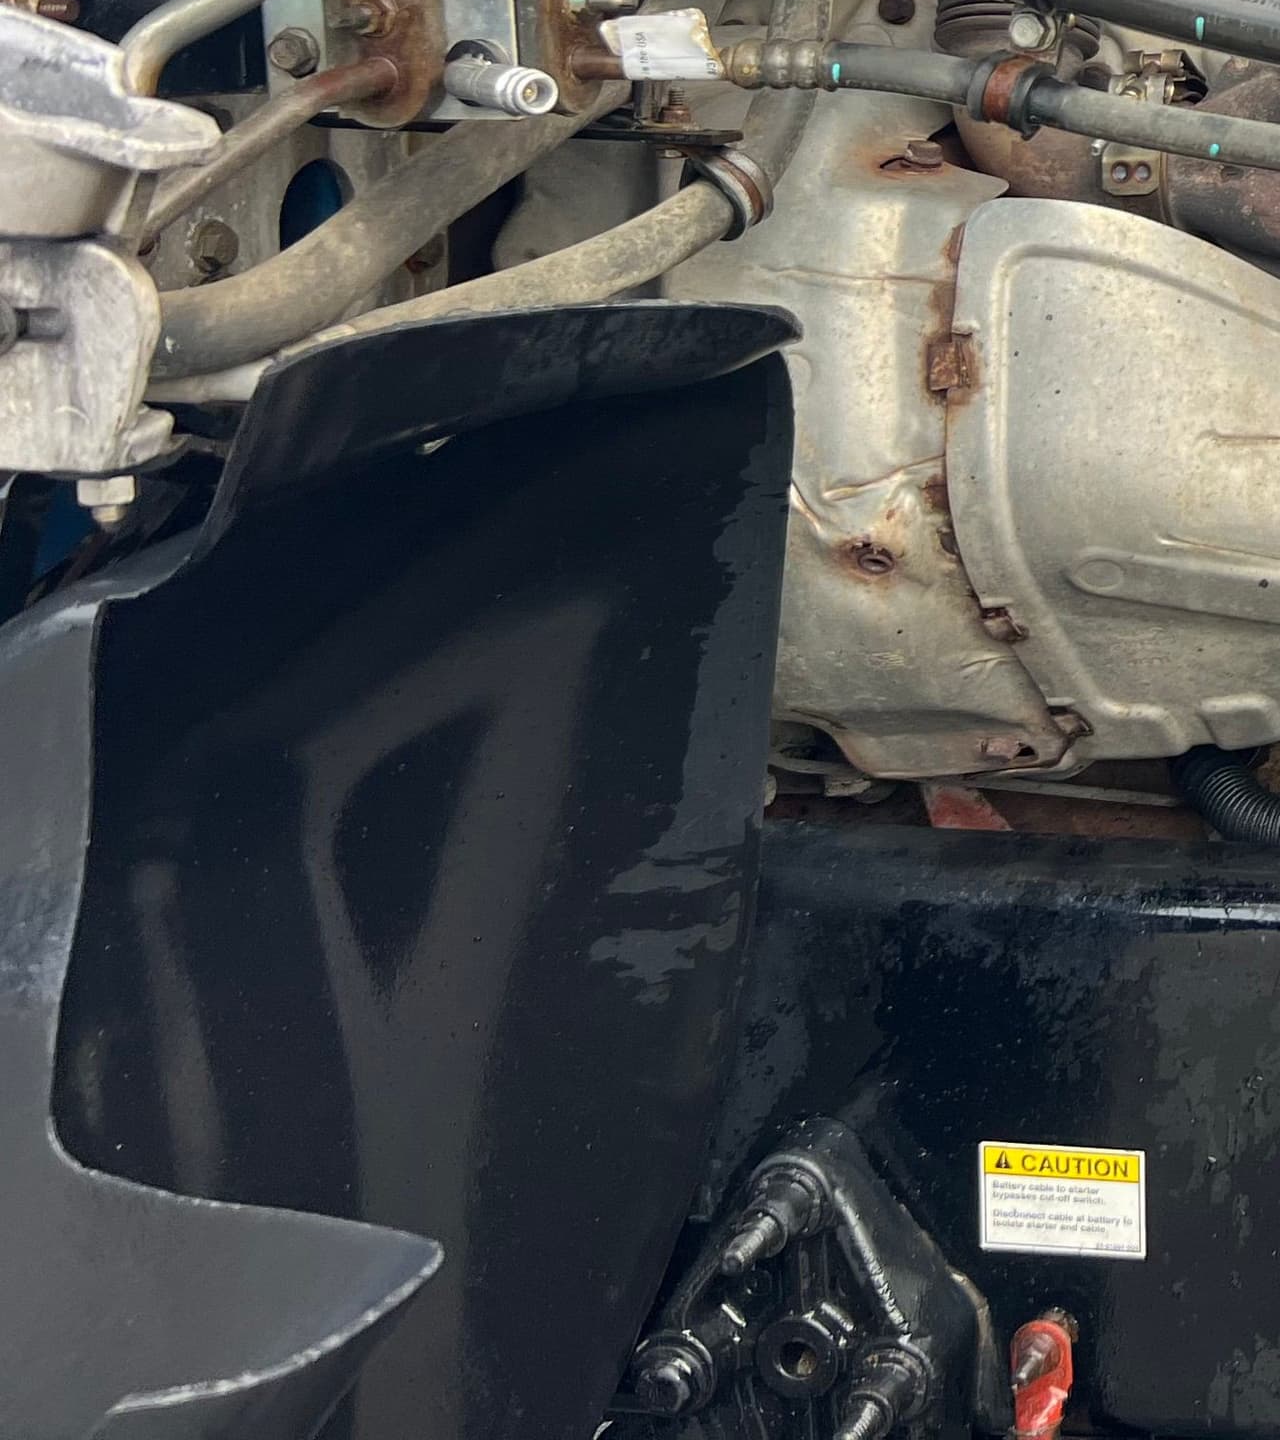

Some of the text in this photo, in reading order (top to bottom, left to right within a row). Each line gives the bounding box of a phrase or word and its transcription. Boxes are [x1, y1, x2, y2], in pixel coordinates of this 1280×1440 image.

[636, 31, 648, 48] USA
[1021, 1154, 1128, 1177] CAUTION
[992, 1179, 1100, 1195] Battery cable to starter
[992, 1191, 1037, 1202] bypasses
[1039, 1192, 1070, 1203] cut-off
[992, 1209, 1133, 1227] Disconnect cable at battery to
[1026, 1220, 1057, 1230] starter
[1060, 1222, 1078, 1232] and
